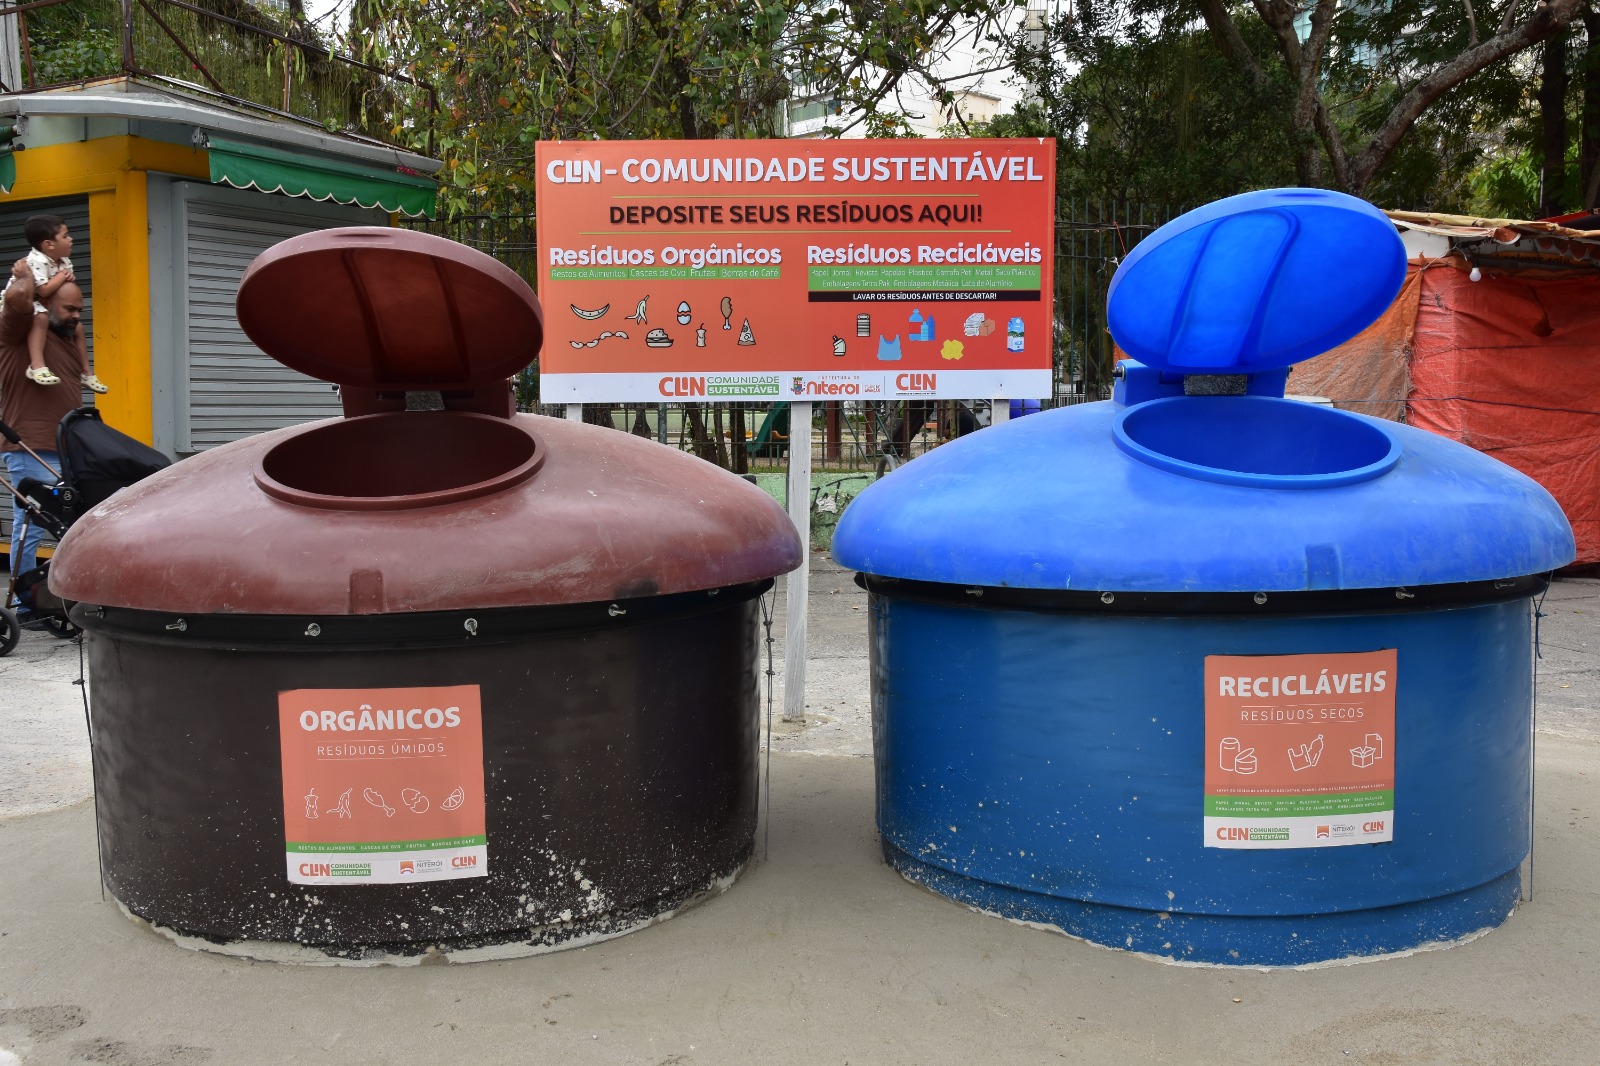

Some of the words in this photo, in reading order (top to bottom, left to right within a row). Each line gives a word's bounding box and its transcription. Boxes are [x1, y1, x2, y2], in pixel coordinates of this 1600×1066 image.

[546, 159, 601, 183] CLIN
[622, 157, 825, 182] COMUNIDADE
[832, 150, 1043, 182] SUSTENTÁVEL
[609, 205, 723, 224] DEPOSITE
[729, 204, 790, 224] SEUS
[796, 200, 913, 223] RESÍDUOS
[918, 204, 982, 226] AQUI!
[550, 244, 655, 265] Resíduos
[660, 242, 782, 270] Orgânicos
[807, 243, 912, 264] Resíduos
[917, 241, 1042, 264] Recicláveis
[551, 269, 577, 278] Restos
[578, 269, 588, 278] de
[588, 269, 626, 278] Alimentos
[630, 268, 658, 277] Cascas
[659, 268, 669, 277] de
[690, 268, 716, 277] Frutas
[721, 268, 748, 277] Borras
[749, 268, 760, 277] de
[761, 268, 778, 277] Café
[960, 268, 972, 276] Pet
[975, 268, 993, 276] Metal
[876, 292, 886, 300] OS
[887, 291, 921, 300] RESÍDUOS
[921, 292, 944, 300] ANTES
[945, 292, 954, 300] DE
[955, 292, 997, 300] DESCARTAR!
[658, 376, 705, 397] CLIN
[707, 376, 779, 384] COMUNIDADE
[895, 373, 937, 391] CLIN
[708, 384, 778, 394] SUSTENTÁVEL
[1219, 668, 1387, 698] RECICLÁVEIS
[299, 704, 461, 732] ORGÂNICOS
[1241, 707, 1314, 721] RESÍDUOS
[1320, 707, 1364, 719] SECOS
[317, 744, 385, 757] RESÍDUOS
[391, 742, 445, 755] ÚMIDOS
[1216, 826, 1249, 841] CLIN
[298, 863, 331, 877] CLIN
[416, 859, 443, 868] NITERÓI
